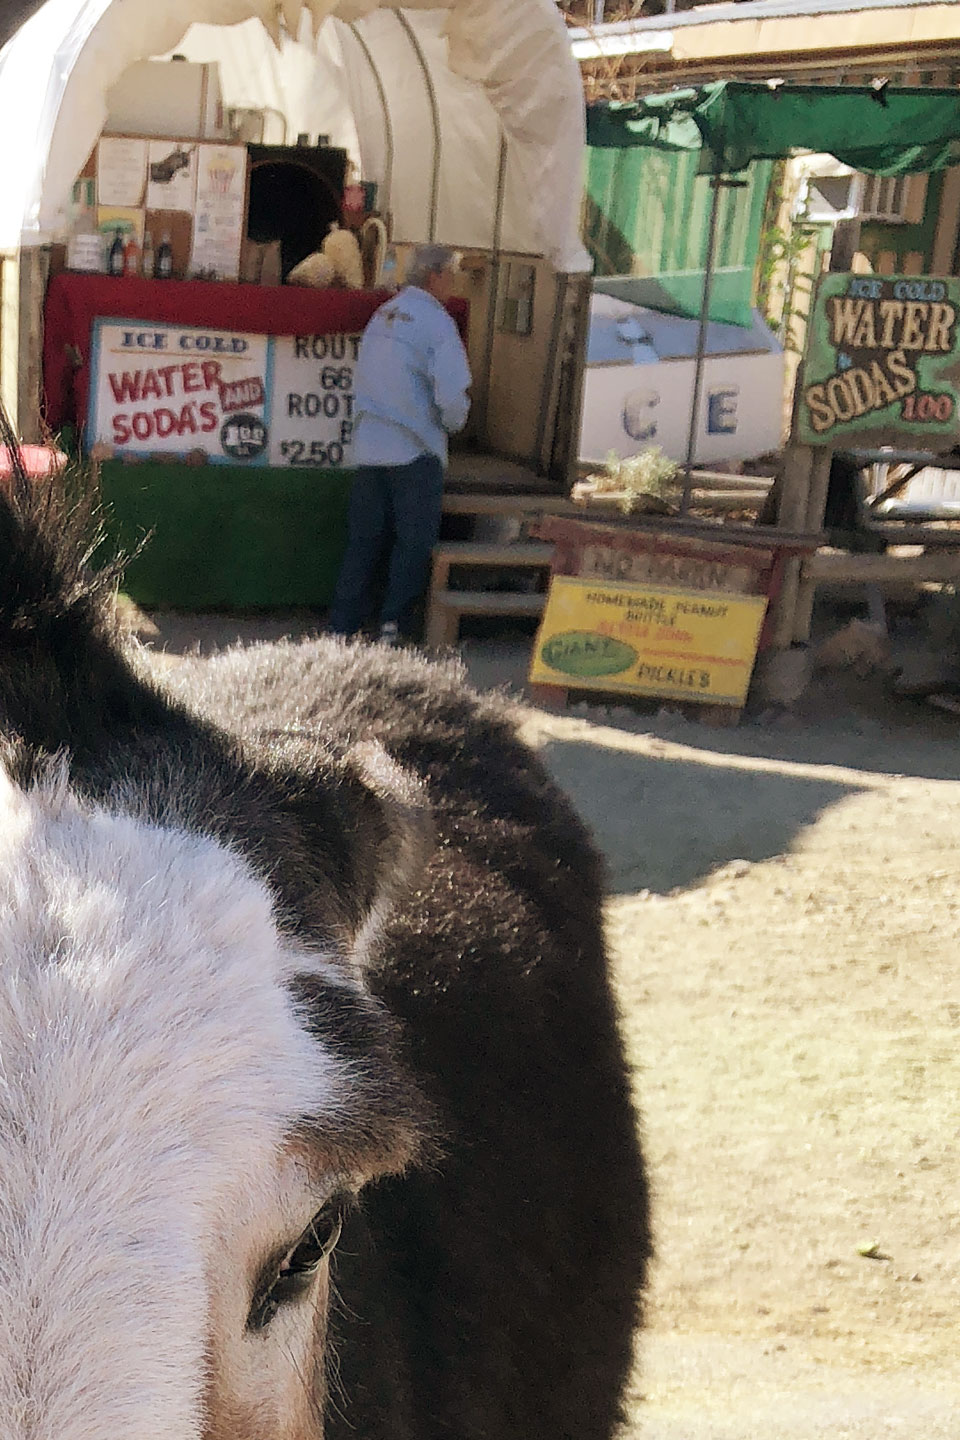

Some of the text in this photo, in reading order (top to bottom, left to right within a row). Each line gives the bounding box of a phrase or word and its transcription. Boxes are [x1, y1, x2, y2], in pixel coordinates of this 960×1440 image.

[894, 280, 945, 300] COLD
[831, 298, 955, 350] WATER
[121, 332, 249, 352] ICE COLD
[108, 360, 222, 404] WATER
[806, 351, 916, 431] SODAS
[288, 393, 355, 418] ROOT
